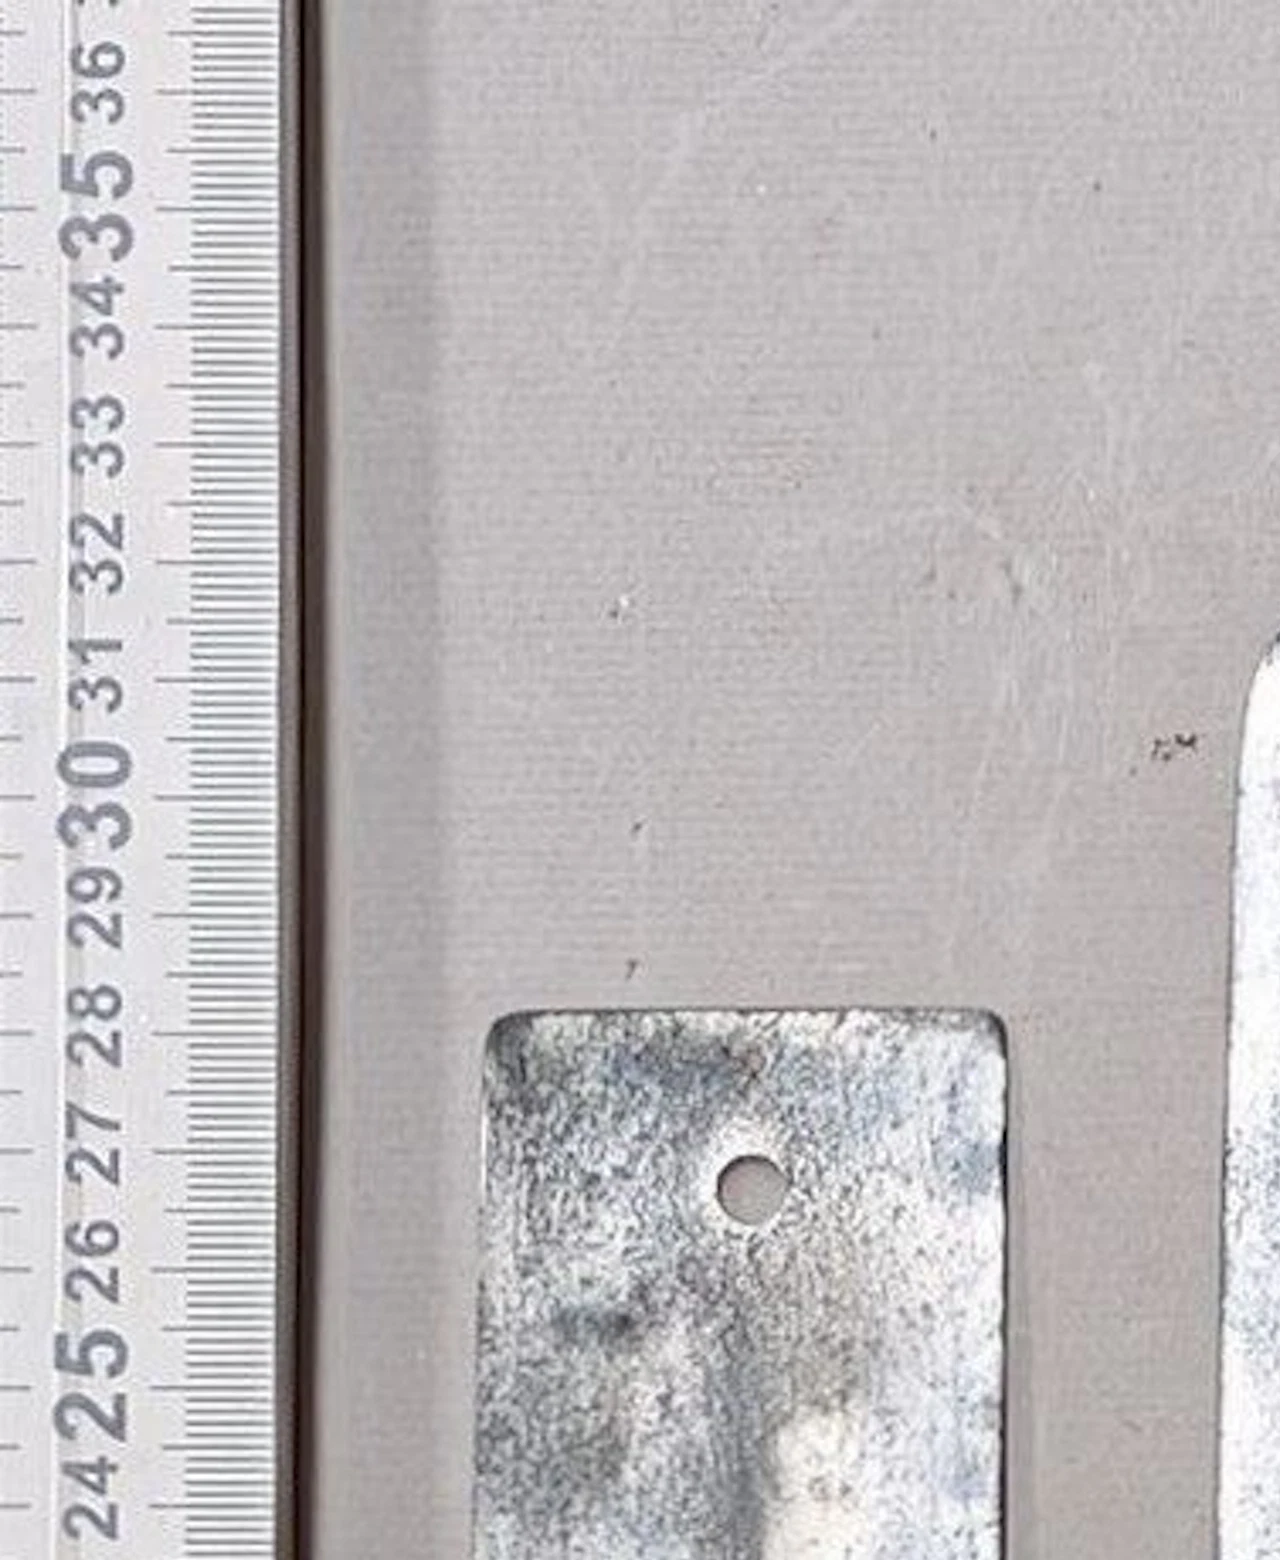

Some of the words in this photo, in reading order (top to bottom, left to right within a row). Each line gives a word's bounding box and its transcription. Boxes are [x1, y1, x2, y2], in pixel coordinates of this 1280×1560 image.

[70, 41, 125, 124] 36
[60, 150, 134, 262] 35
[69, 276, 124, 360] 34
[69, 395, 124, 479] 33
[68, 512, 123, 596] 32
[68, 638, 122, 712] 31
[57, 741, 132, 849] 30
[66, 867, 122, 949] 29
[66, 985, 121, 1069] 28
[65, 1102, 121, 1185] 27
[65, 1219, 120, 1303] 26
[54, 1329, 128, 1442] 25
[62, 1456, 118, 1540] 24
